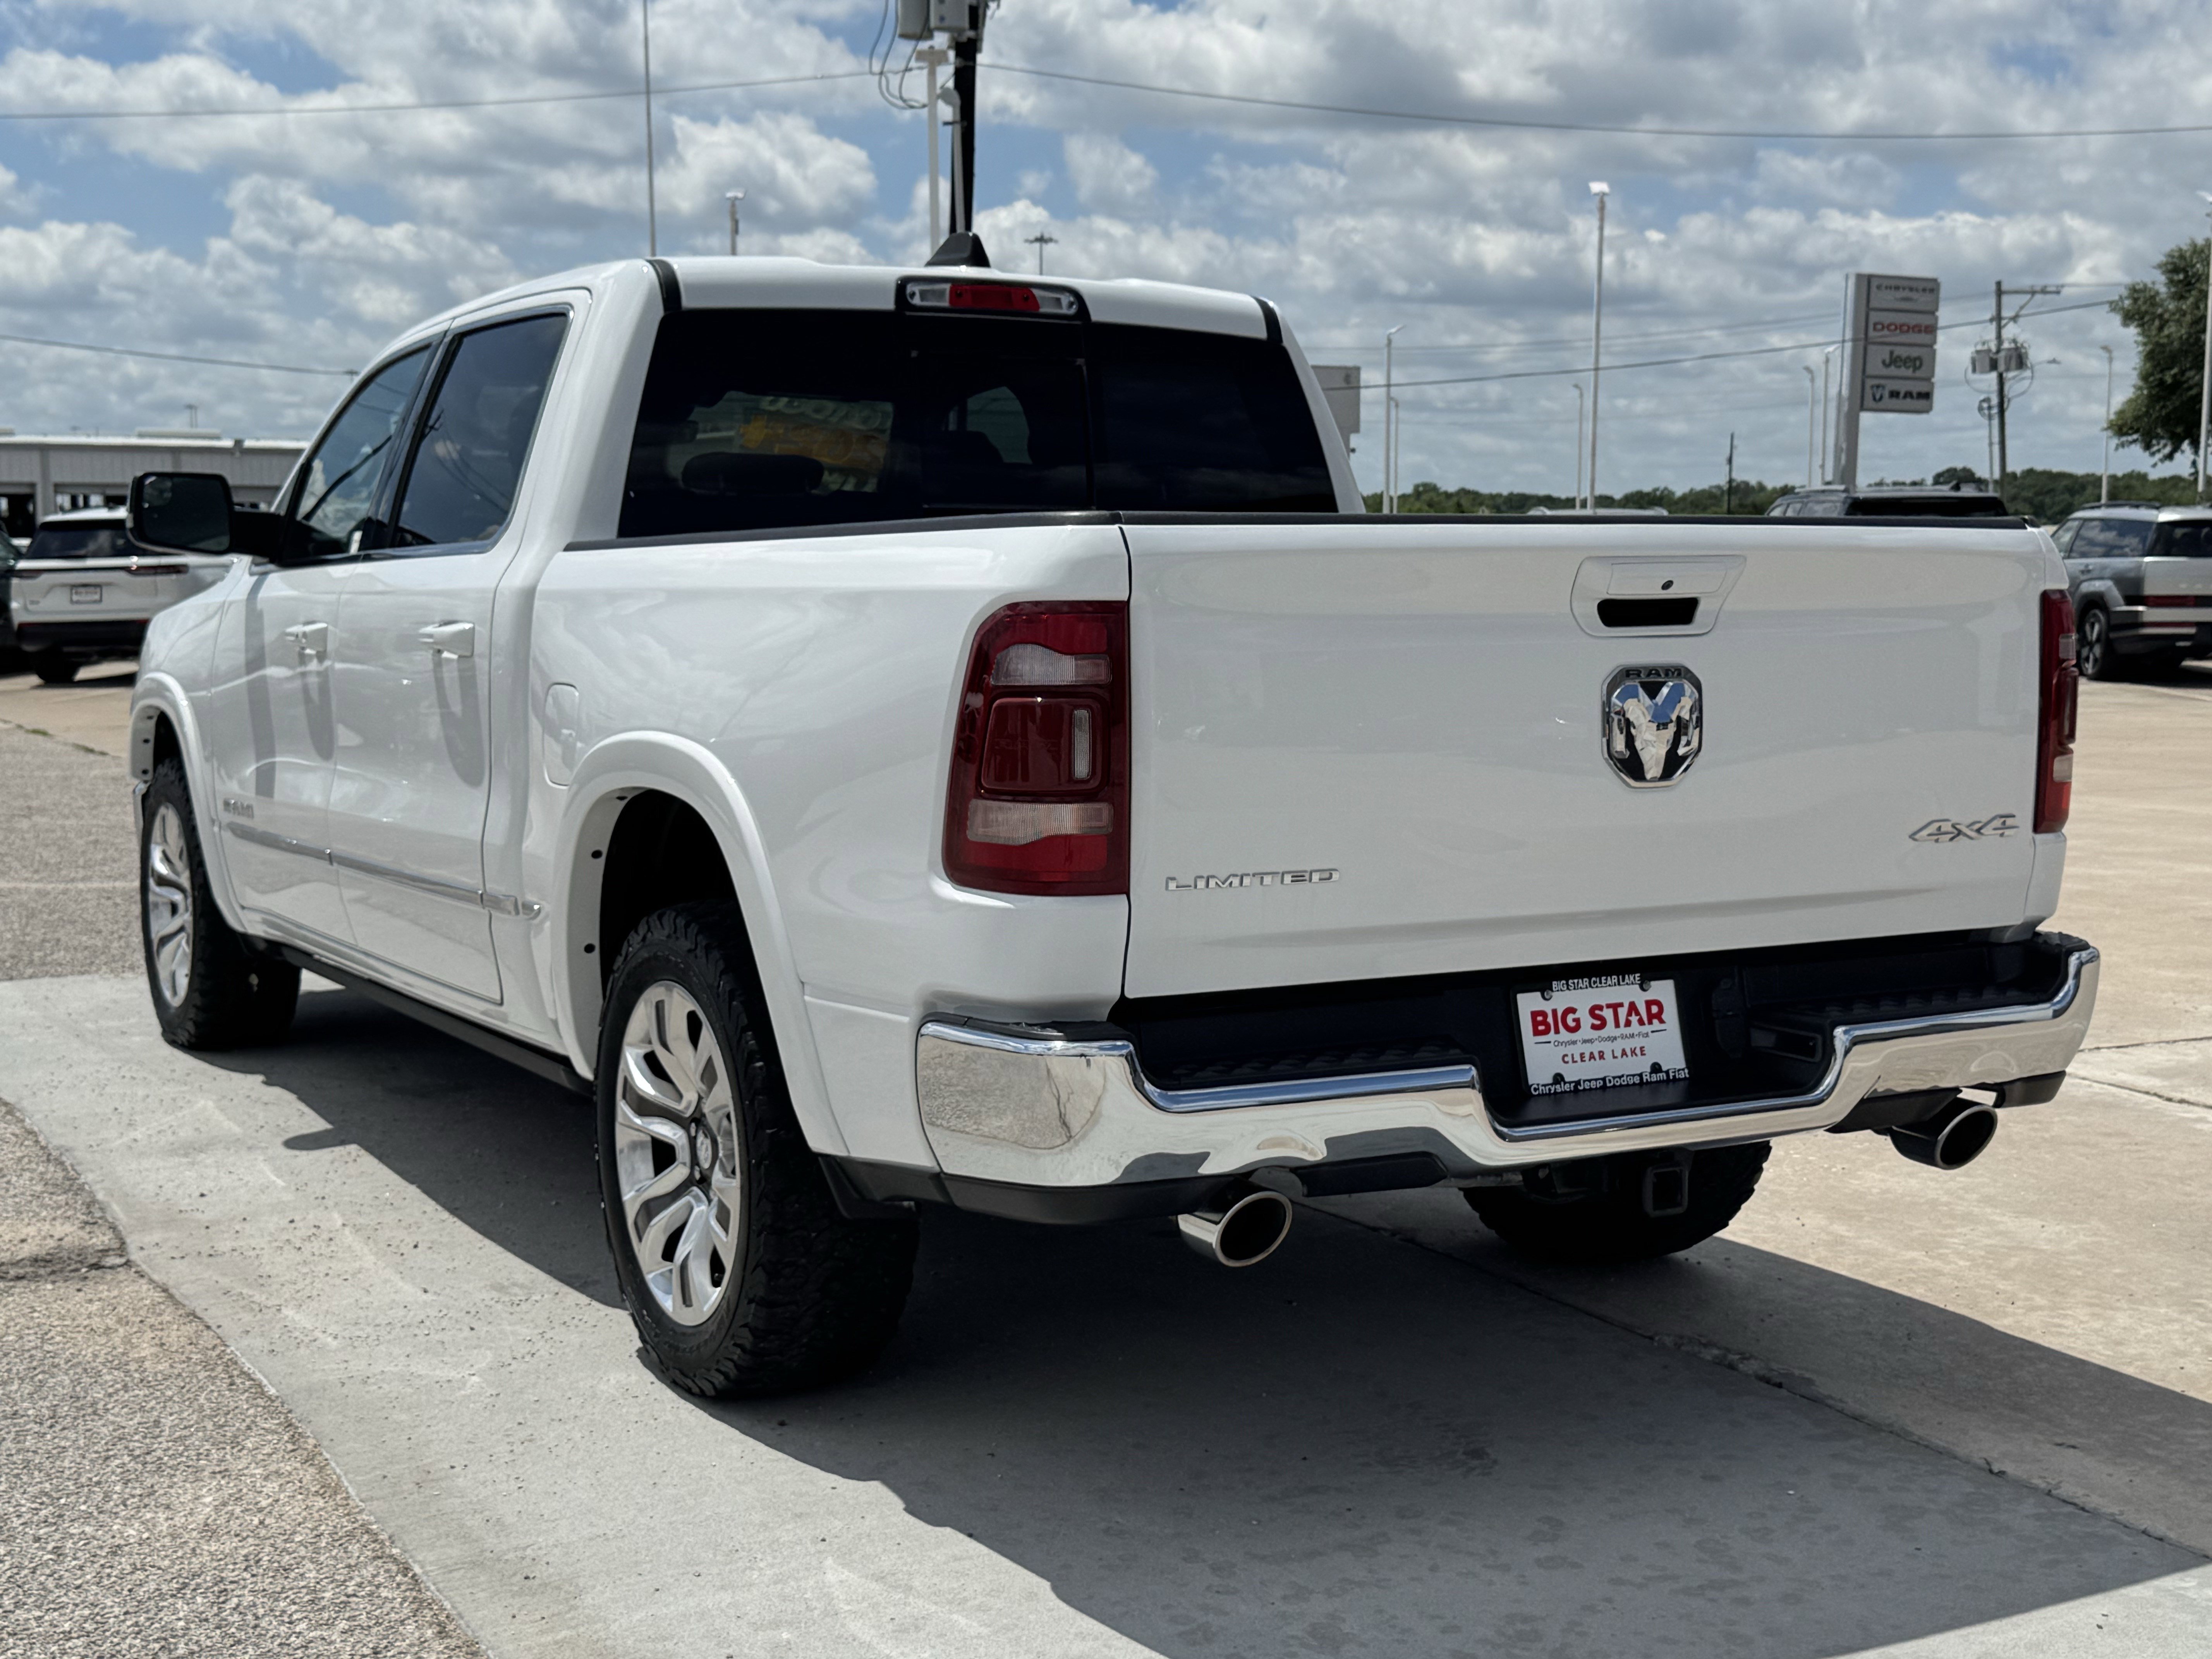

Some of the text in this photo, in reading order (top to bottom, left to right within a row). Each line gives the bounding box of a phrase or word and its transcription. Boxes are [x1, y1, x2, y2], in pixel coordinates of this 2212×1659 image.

[1873, 322, 1935, 335] DODGE
[1882, 350, 1923, 373] Jeep
[1888, 389, 1930, 401] RAM
[1625, 668, 1682, 678] RAM
[1166, 869, 1340, 890] LIMITED
[1552, 973, 1641, 991] BIG STAR CLEAR LAKE
[1530, 999, 1666, 1036] BIG STAR
[1561, 1046, 1646, 1064] CLEAR LAKE
[1531, 1068, 1689, 1095] Chrysler Jeep Dodge Ram Fiat
